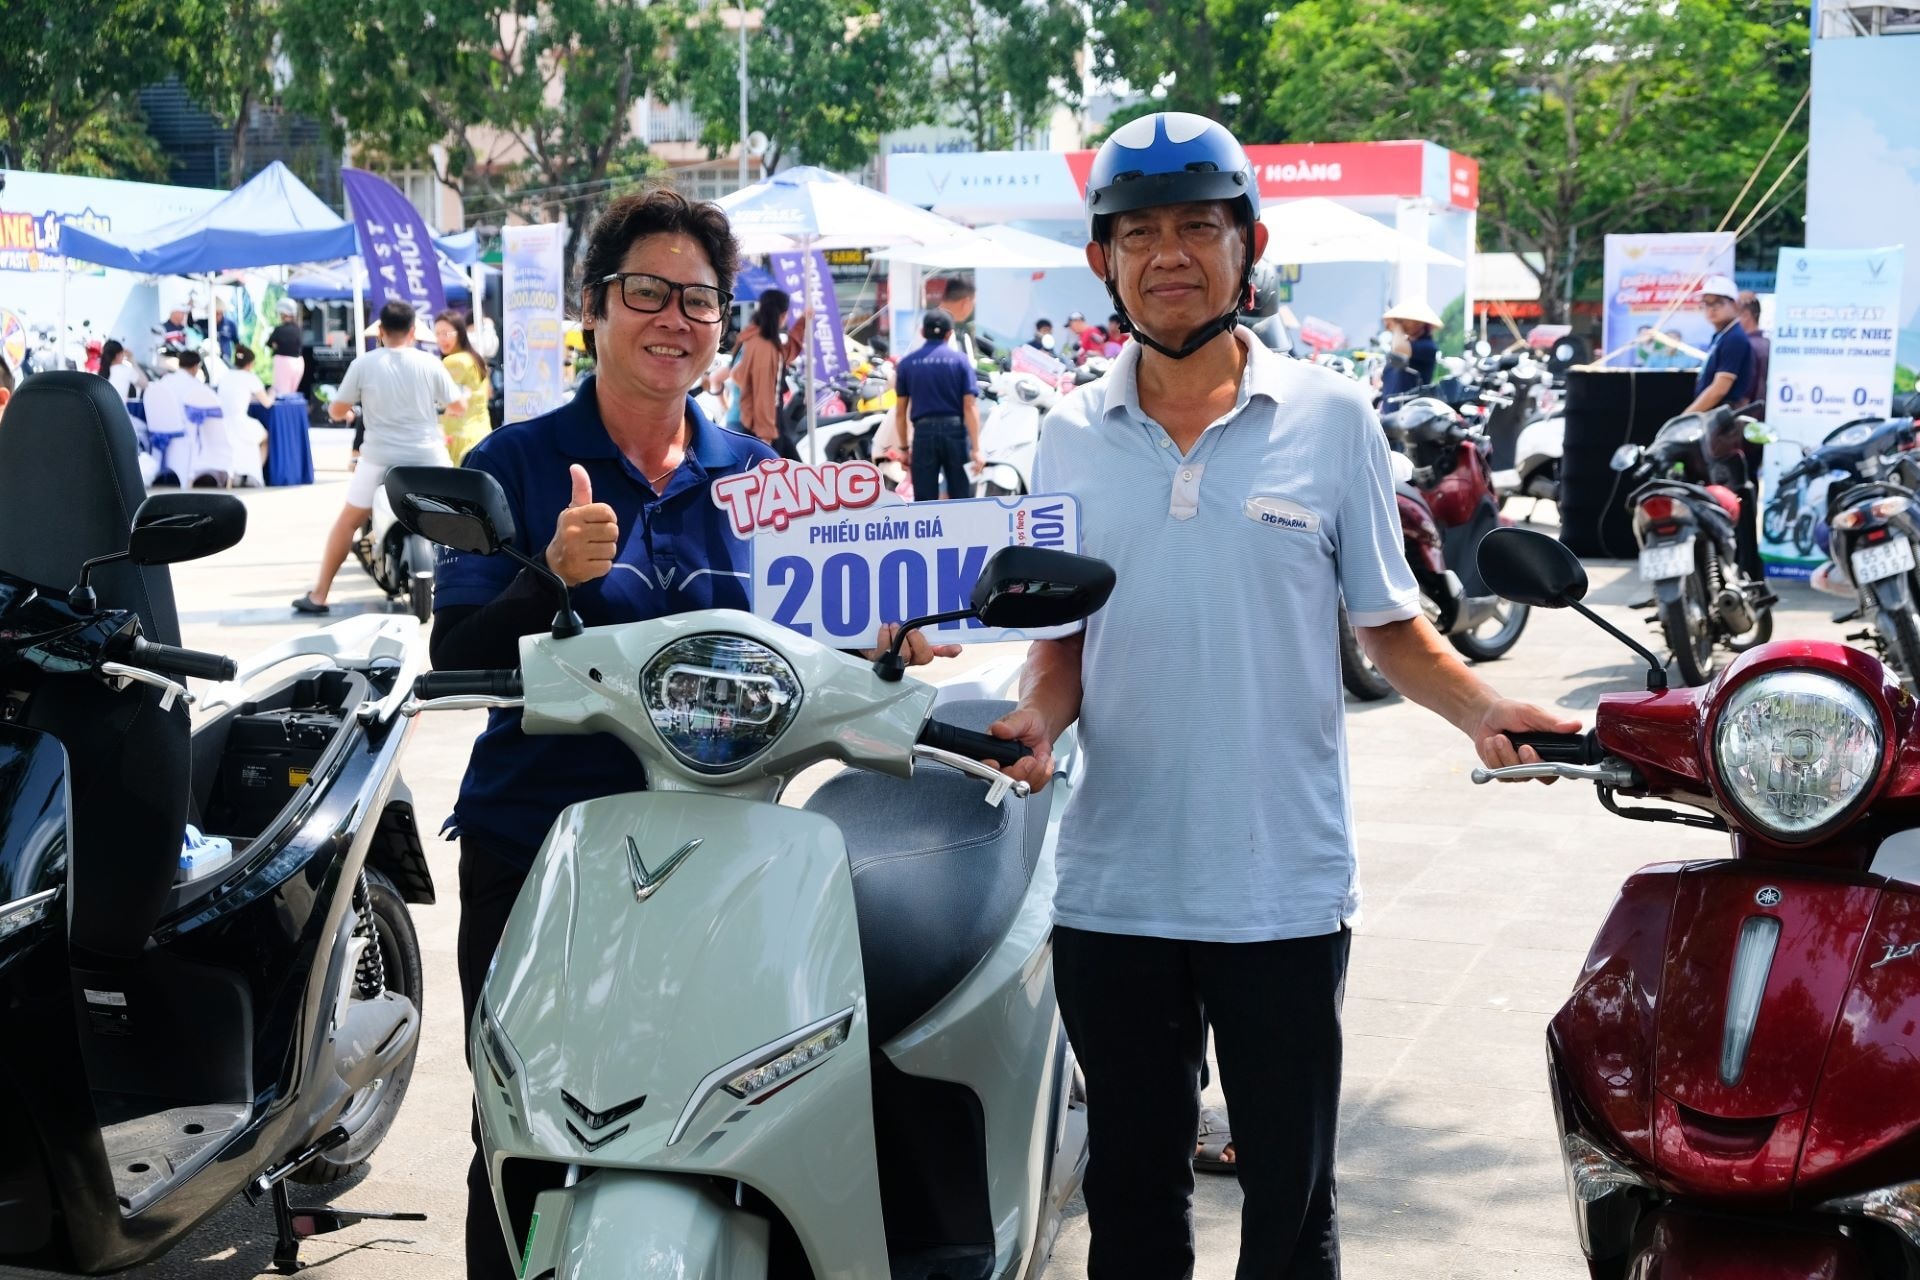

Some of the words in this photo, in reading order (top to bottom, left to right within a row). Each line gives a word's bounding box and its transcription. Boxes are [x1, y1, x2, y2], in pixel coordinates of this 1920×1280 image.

[961, 175, 1040, 186] VINFAST
[1265, 160, 1342, 182] HOÀNG
[393, 222, 429, 297] PHÚC
[1803, 327, 1827, 339] VAY
[715, 458, 881, 535] TẶNG
[809, 518, 860, 545] PHIẾU
[865, 516, 909, 542] GIẢM
[914, 515, 944, 539] GIÁ
[1261, 512, 1277, 524] CHG
[1277, 517, 1307, 529] PHARMA
[766, 545, 992, 639] 200K
